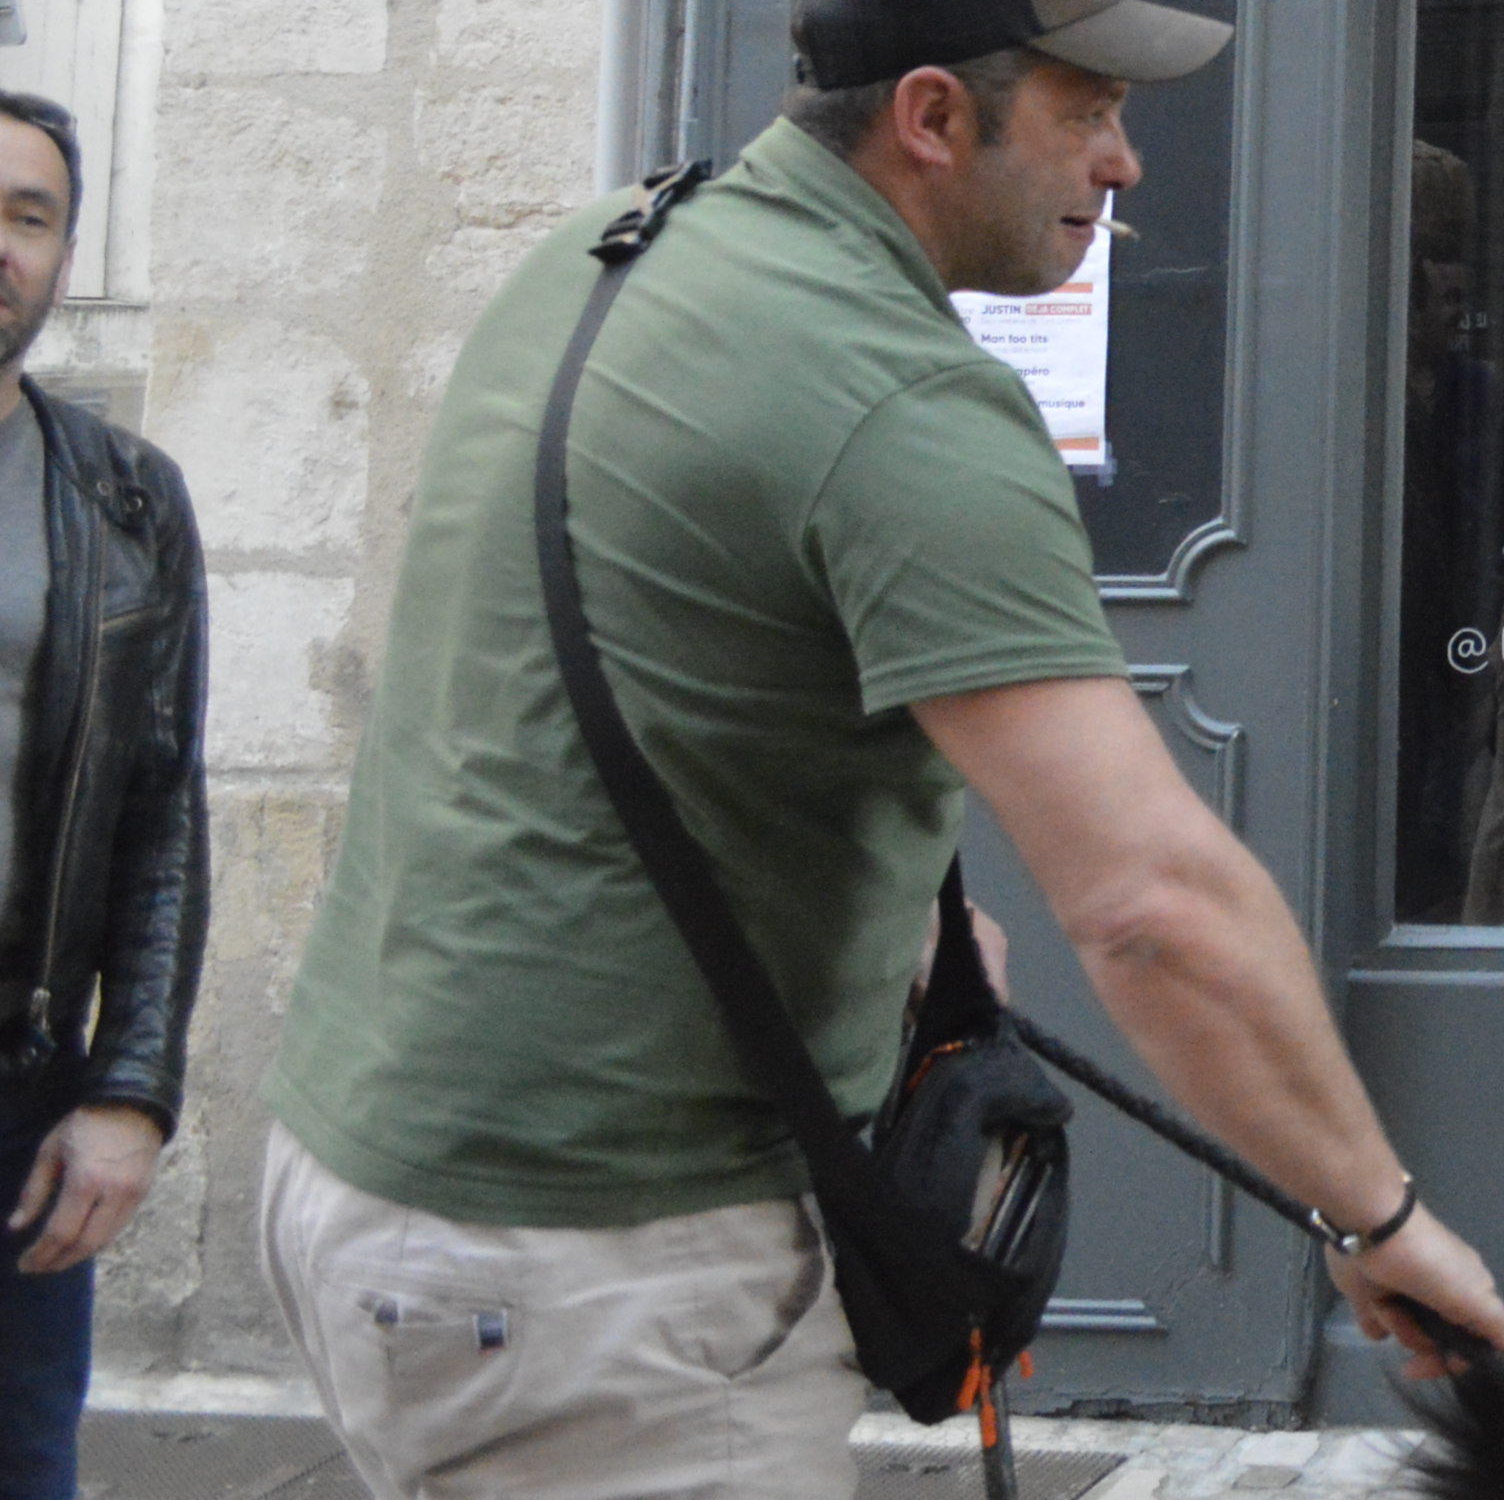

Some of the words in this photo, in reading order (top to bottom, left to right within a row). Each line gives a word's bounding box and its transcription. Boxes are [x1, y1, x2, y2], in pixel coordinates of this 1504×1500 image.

[981, 305, 1021, 315] JUSTIN
[1008, 334, 1027, 344] foo
[1030, 334, 1048, 344] tits
